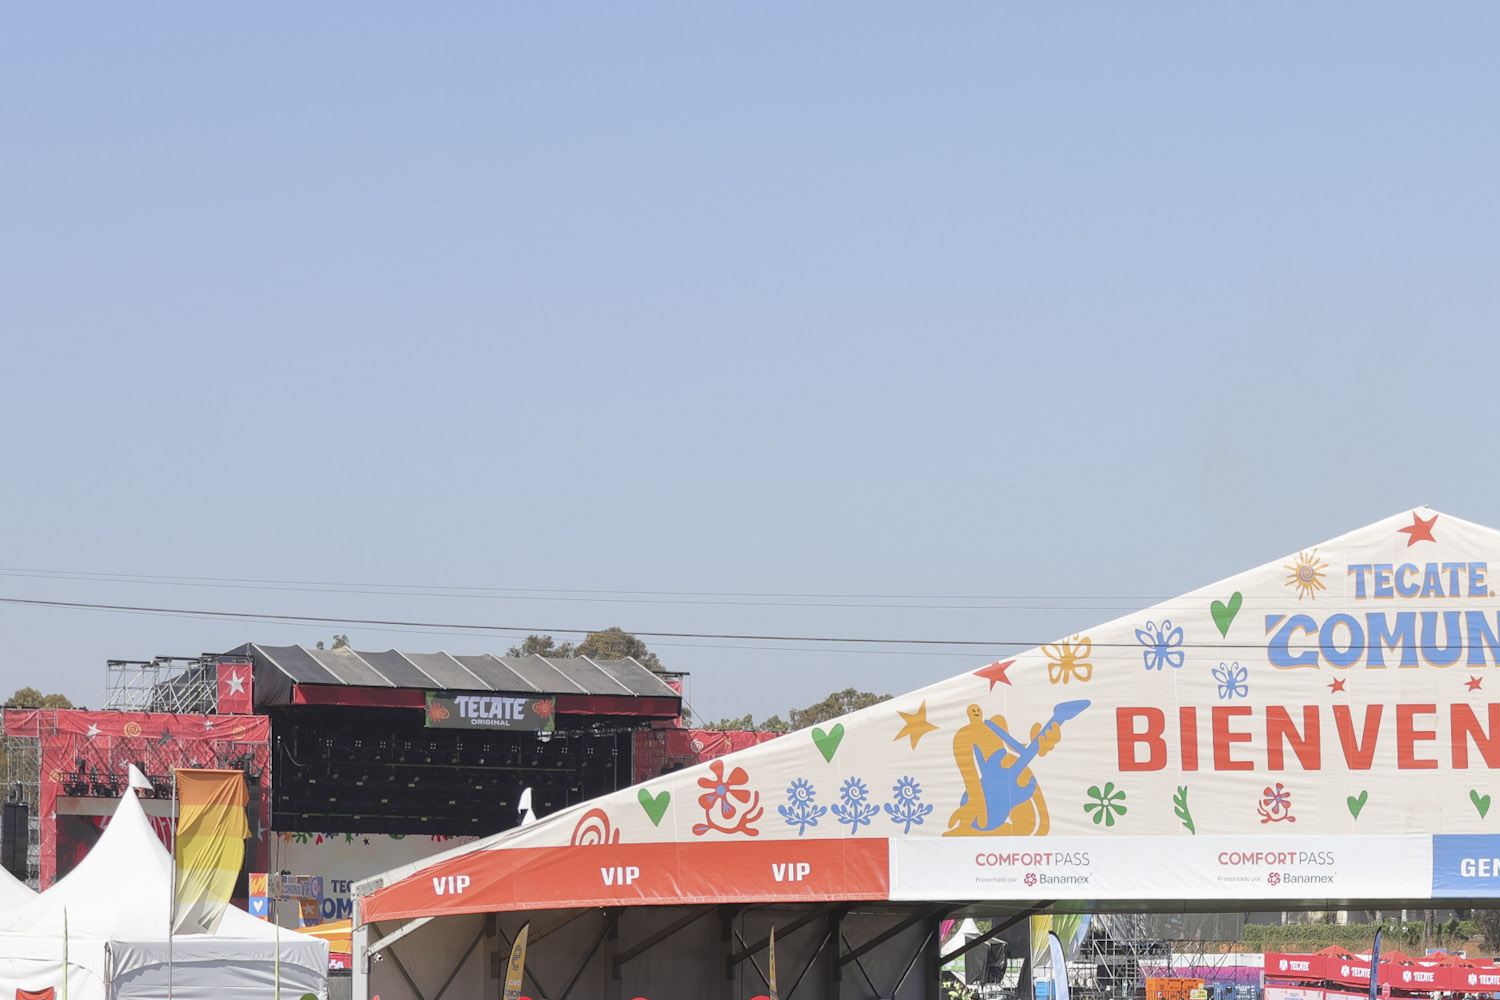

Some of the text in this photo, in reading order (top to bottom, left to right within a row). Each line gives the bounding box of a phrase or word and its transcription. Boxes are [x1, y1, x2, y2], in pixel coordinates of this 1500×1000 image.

[454, 696, 529, 720] TECATE
[601, 865, 640, 886] VIP
[772, 863, 811, 882] VIP
[1283, 873, 1334, 883] Banamex
[1039, 874, 1089, 884] Banamex
[433, 875, 471, 895] VIP
[1289, 961, 1310, 971] TECATE
[1351, 967, 1371, 978] TECATE
[1413, 971, 1435, 982] TECATE
[1479, 975, 1500, 985] TECATE
